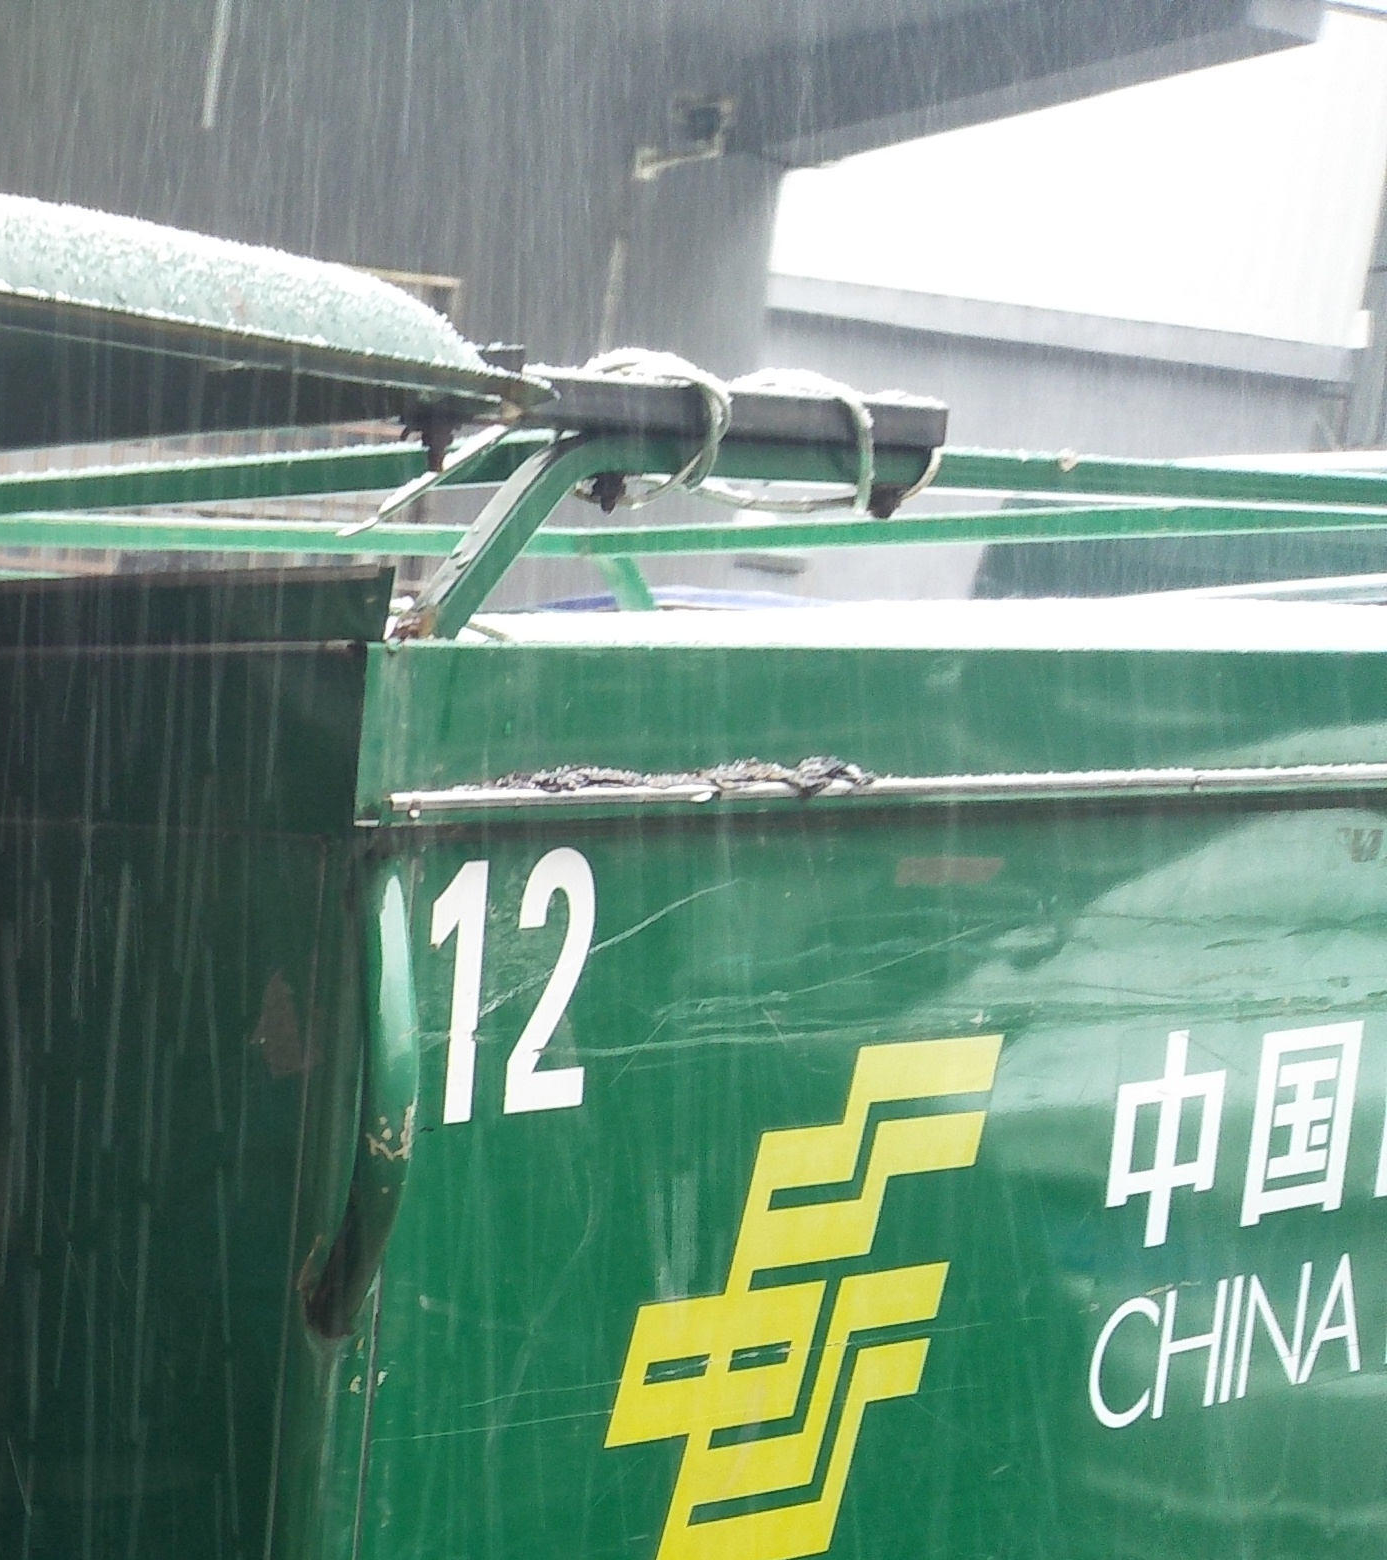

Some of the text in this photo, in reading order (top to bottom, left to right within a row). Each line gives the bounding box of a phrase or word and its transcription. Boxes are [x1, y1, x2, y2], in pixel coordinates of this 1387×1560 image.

[430, 847, 596, 1125] 12
[1105, 1020, 1387, 1248] 中国
[1089, 1253, 1361, 1428] CHINA
